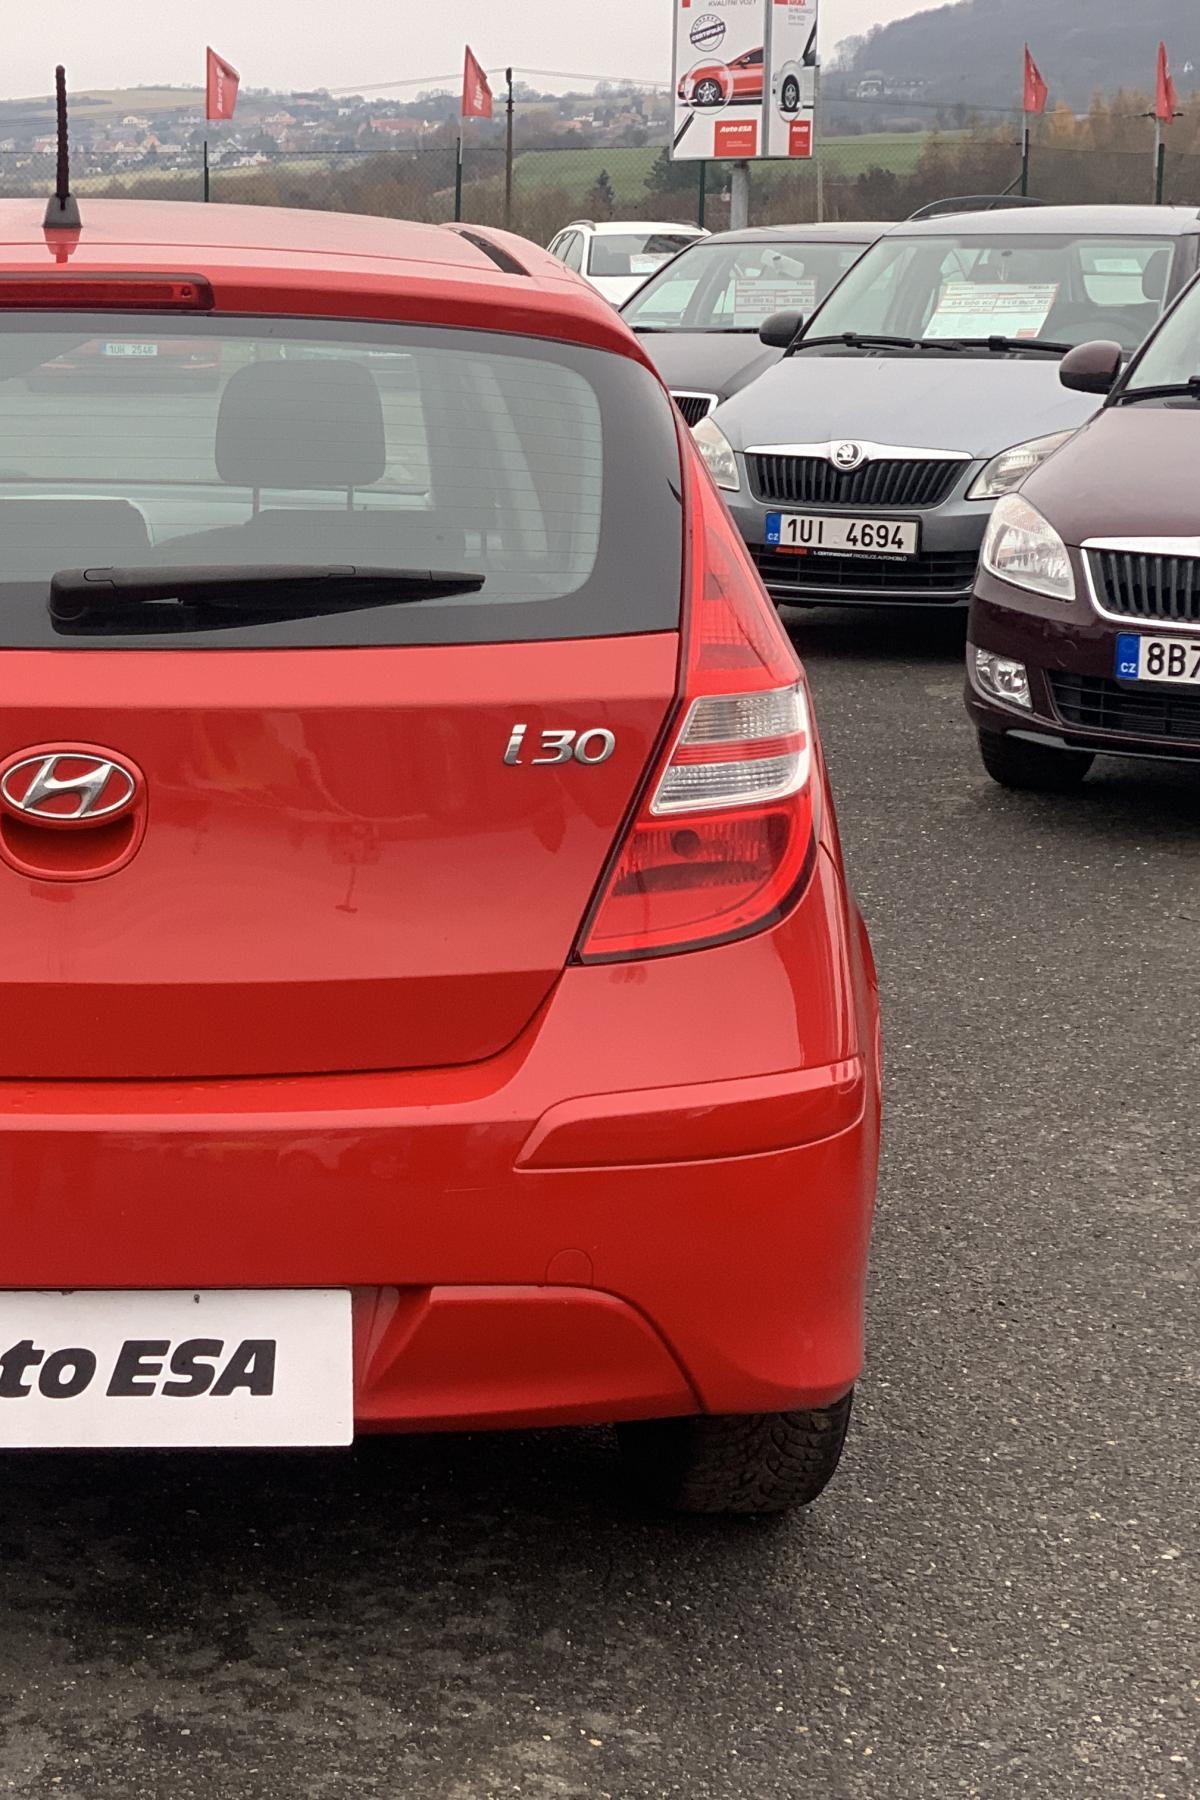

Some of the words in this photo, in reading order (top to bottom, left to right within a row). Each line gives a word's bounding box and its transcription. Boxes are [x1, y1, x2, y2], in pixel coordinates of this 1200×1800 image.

[767, 533, 779, 541] CZ
[787, 518, 824, 544] 1UI
[845, 522, 905, 549] 4694
[1120, 662, 1137, 673] CZ
[106, 1338, 276, 1397] ESA
